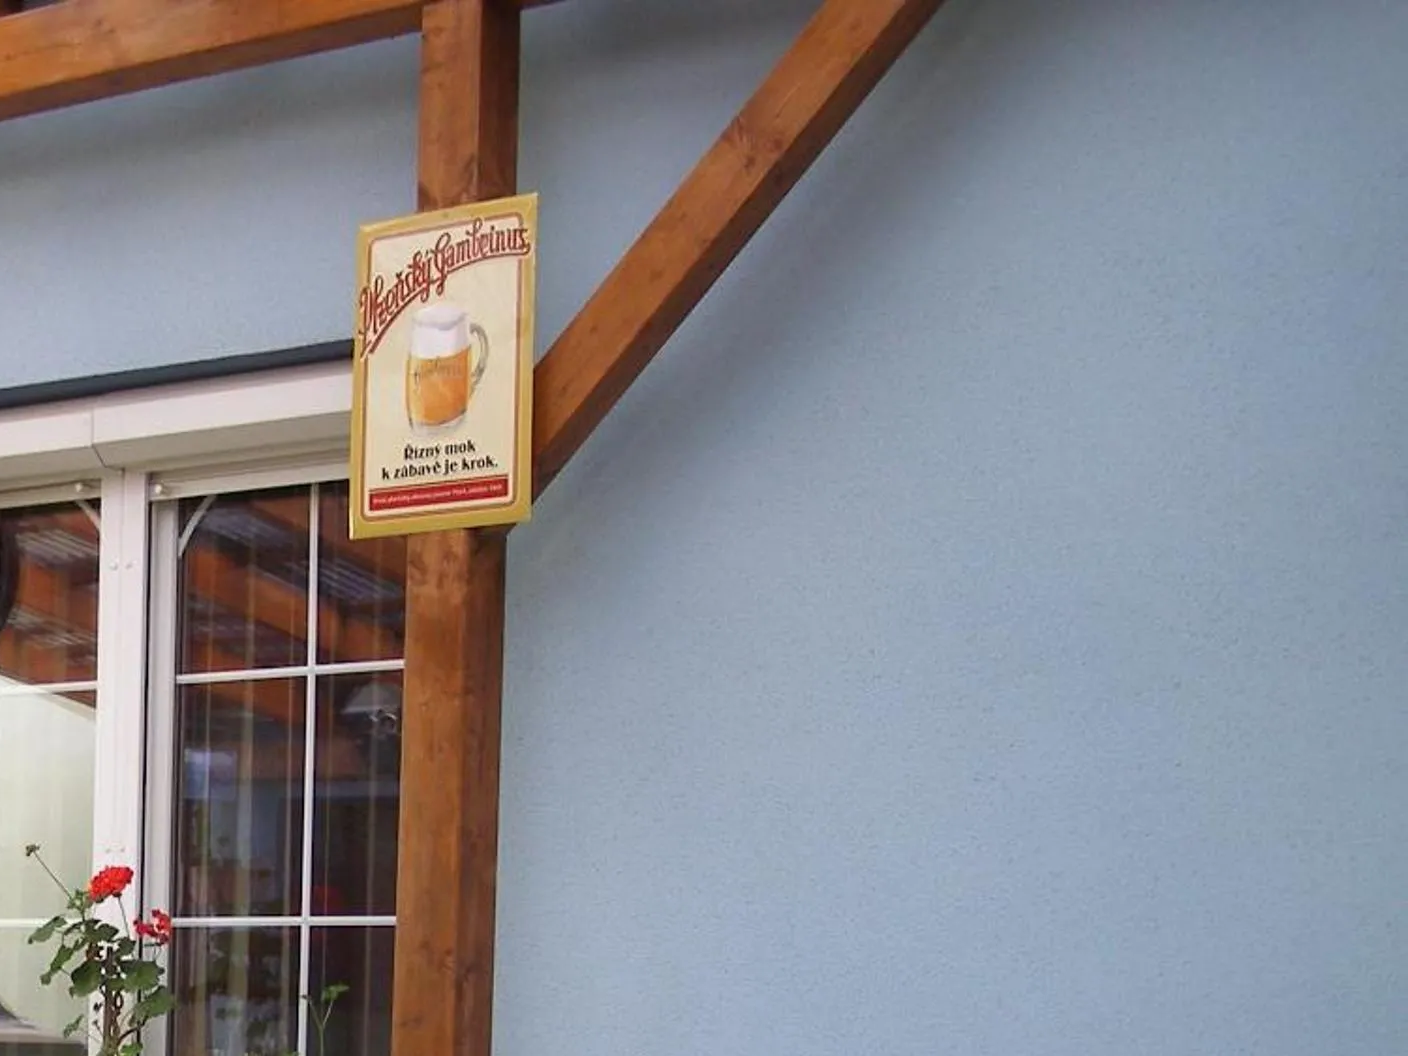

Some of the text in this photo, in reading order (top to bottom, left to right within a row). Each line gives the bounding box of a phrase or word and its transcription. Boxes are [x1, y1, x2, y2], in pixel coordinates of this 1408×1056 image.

[431, 217, 530, 295] Gambrinus
[444, 439, 476, 456] mok
[381, 467, 390, 480] k
[443, 459, 458, 475] je
